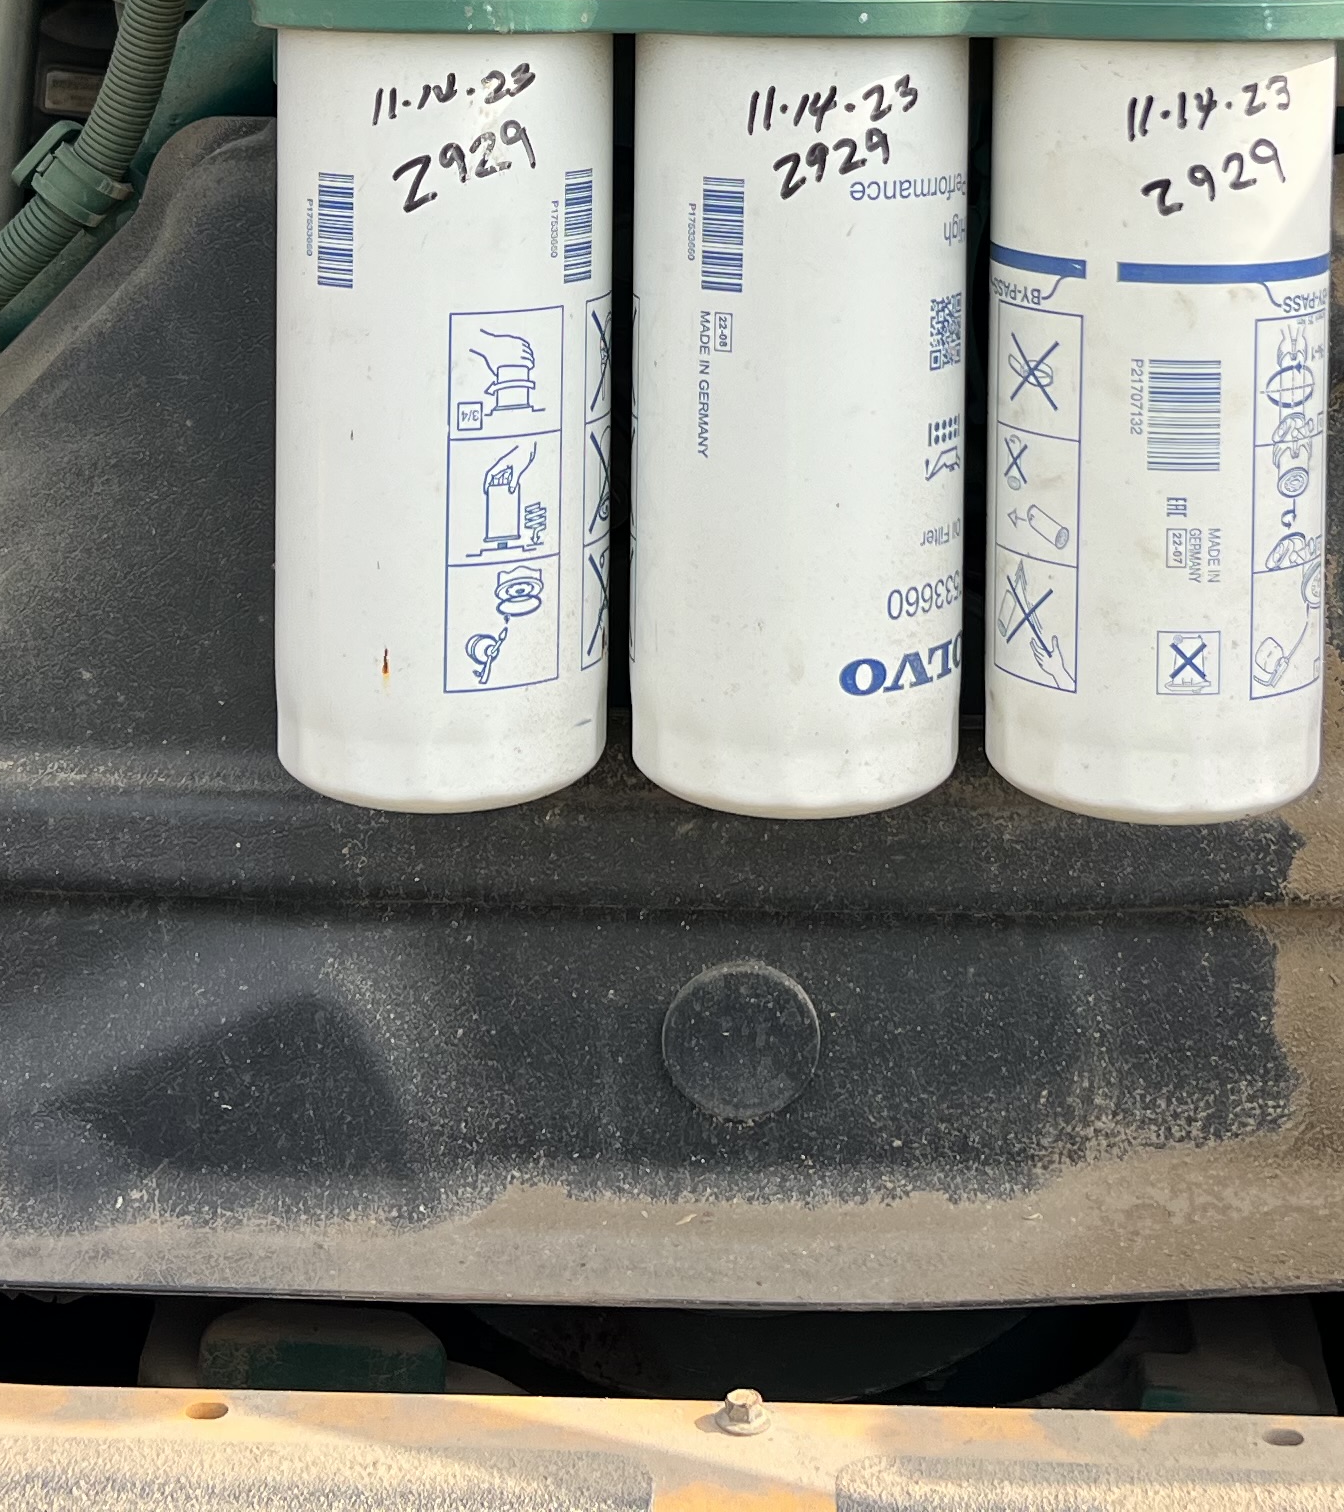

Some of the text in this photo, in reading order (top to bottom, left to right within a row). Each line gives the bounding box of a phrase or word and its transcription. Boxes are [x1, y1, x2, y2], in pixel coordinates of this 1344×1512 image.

[392, 120, 537, 213] 2929
[773, 127, 890, 200] 2929
[1140, 138, 1287, 217] 2929
[718, 315, 728, 349] 22-08
[697, 310, 711, 459] MADE IN GERMANY
[1129, 358, 1144, 436] P21707132
[461, 409, 480, 423] 3/4
[920, 524, 951, 547] Filter
[1171, 531, 1183, 565] 22-07
[1188, 527, 1202, 584] GERMANY
[1208, 527, 1221, 584] MADE IN
[887, 569, 962, 621] 533660
